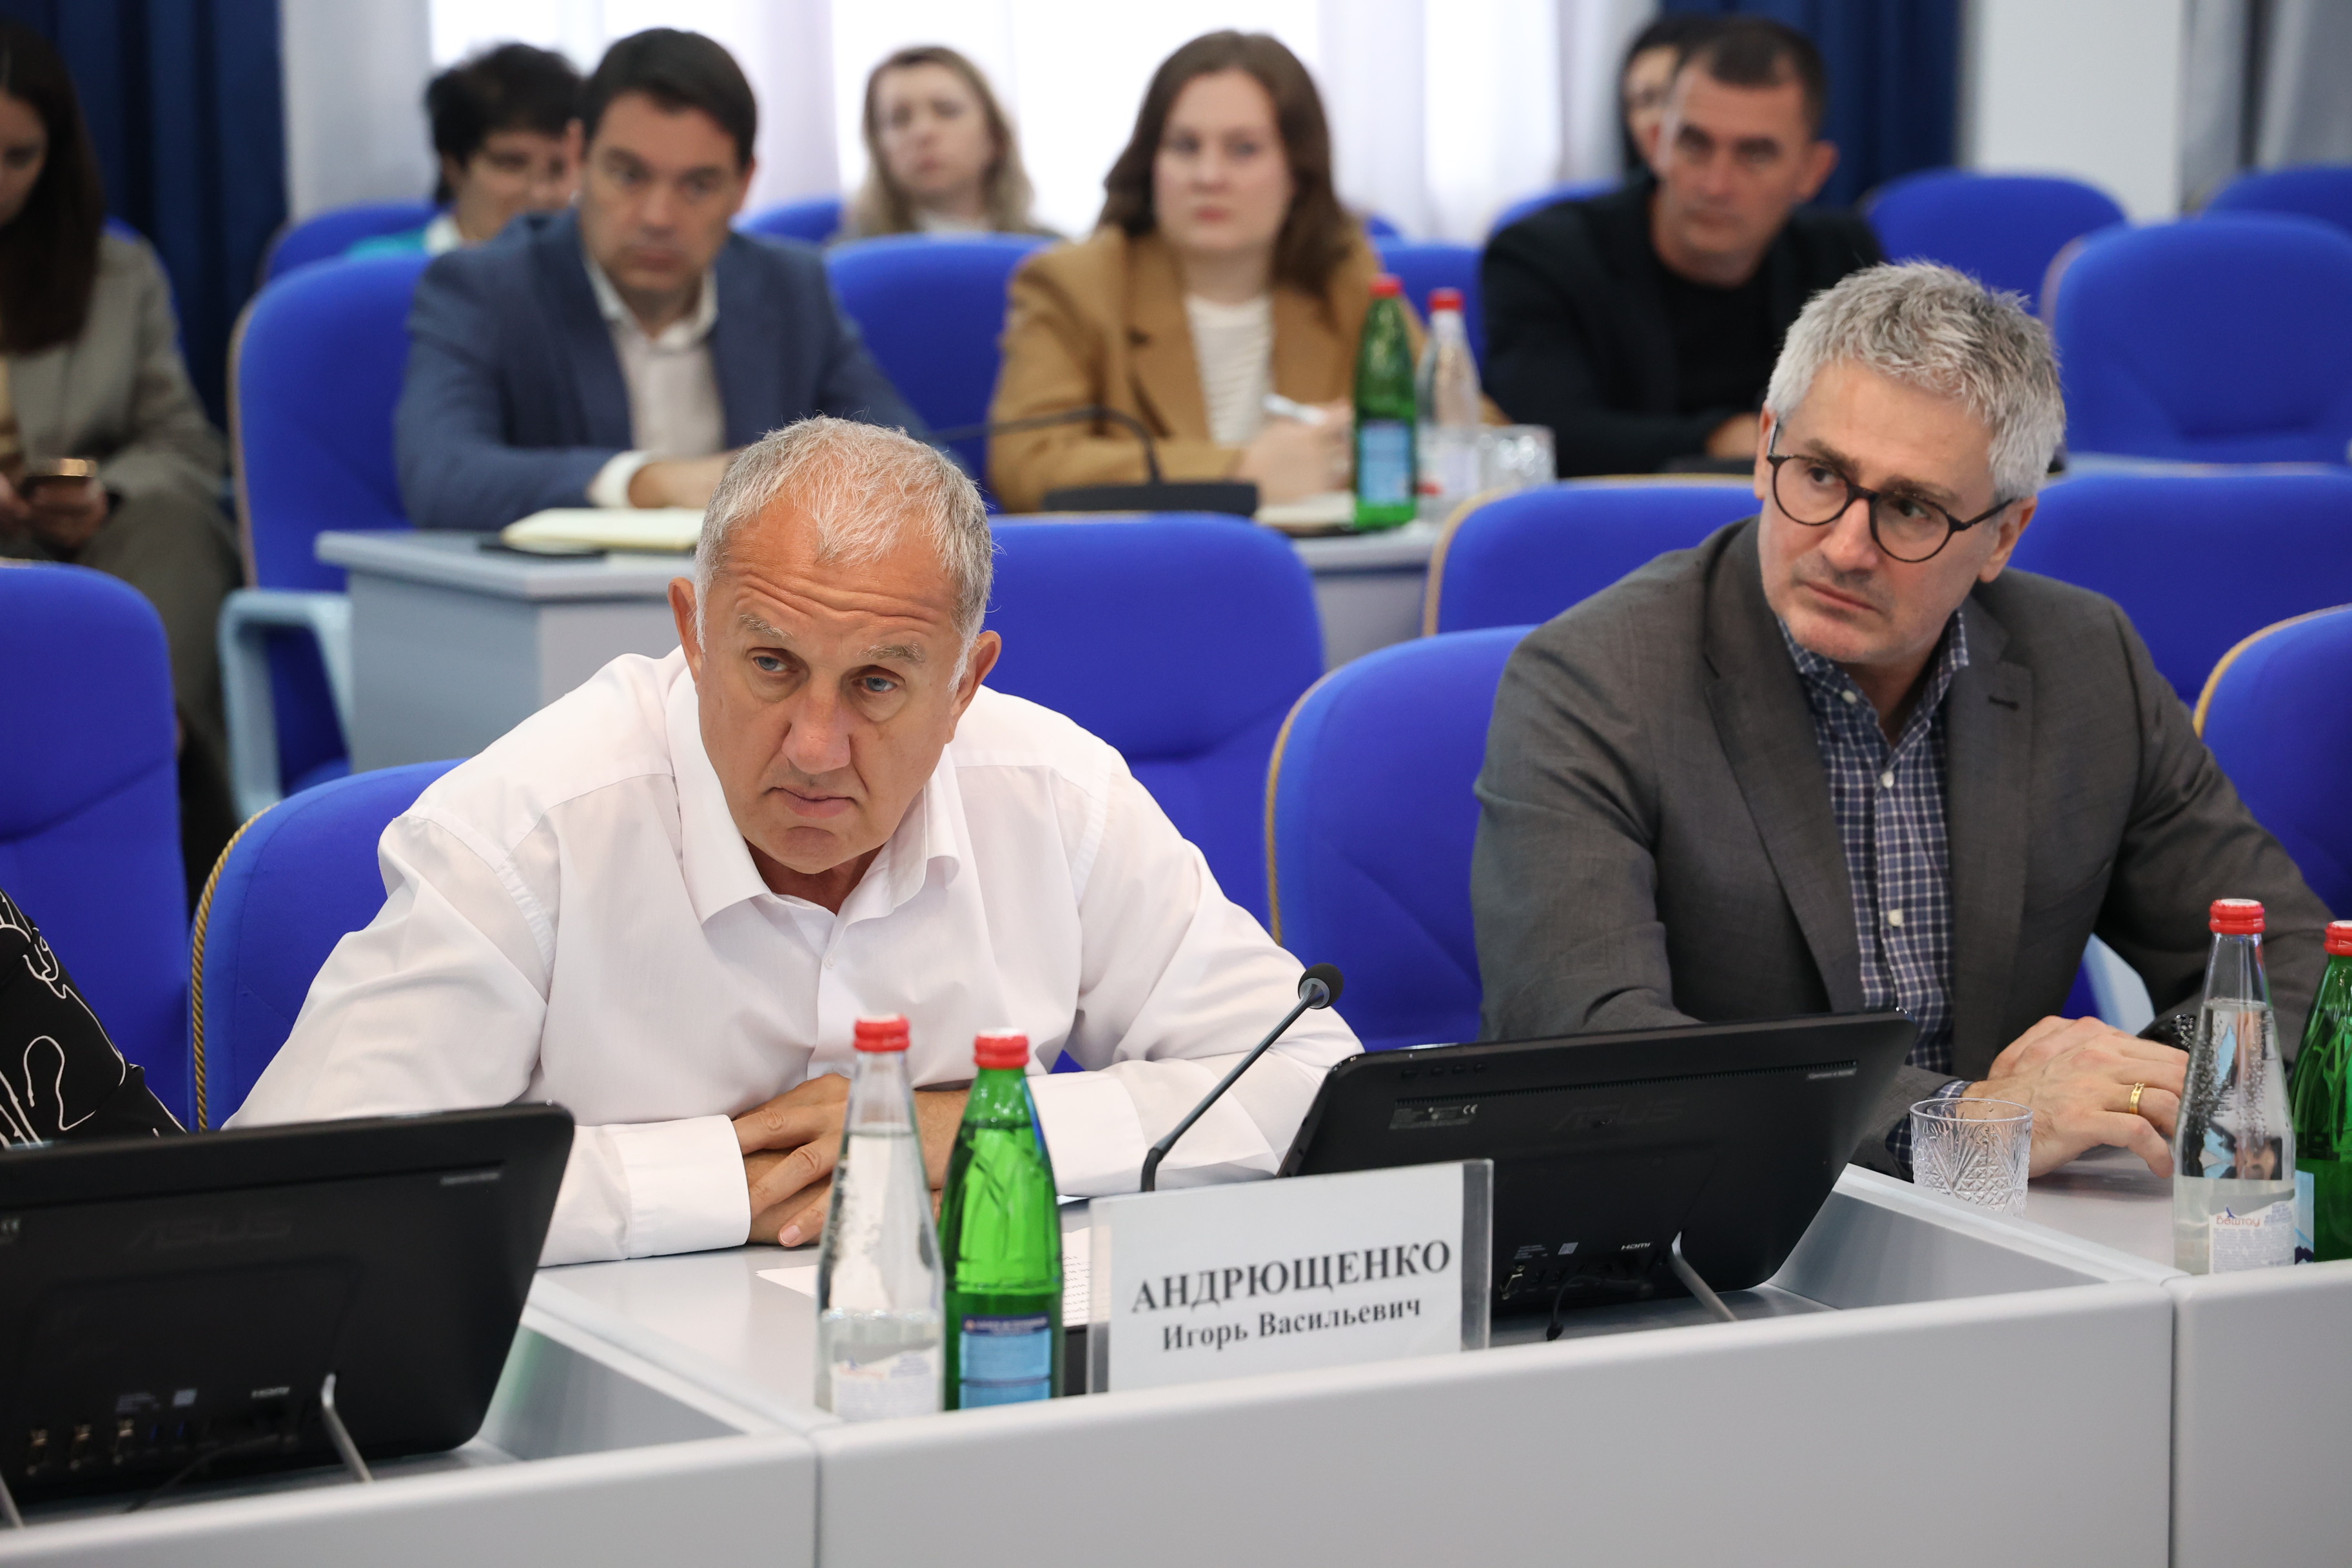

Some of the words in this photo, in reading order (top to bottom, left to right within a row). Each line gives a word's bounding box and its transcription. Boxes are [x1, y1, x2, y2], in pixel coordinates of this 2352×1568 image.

[1131, 1239, 1452, 1314] АНДРЮЩЕНКО
[1161, 1320, 1249, 1353] Игорь
[1258, 1297, 1422, 1338] Васильевич
